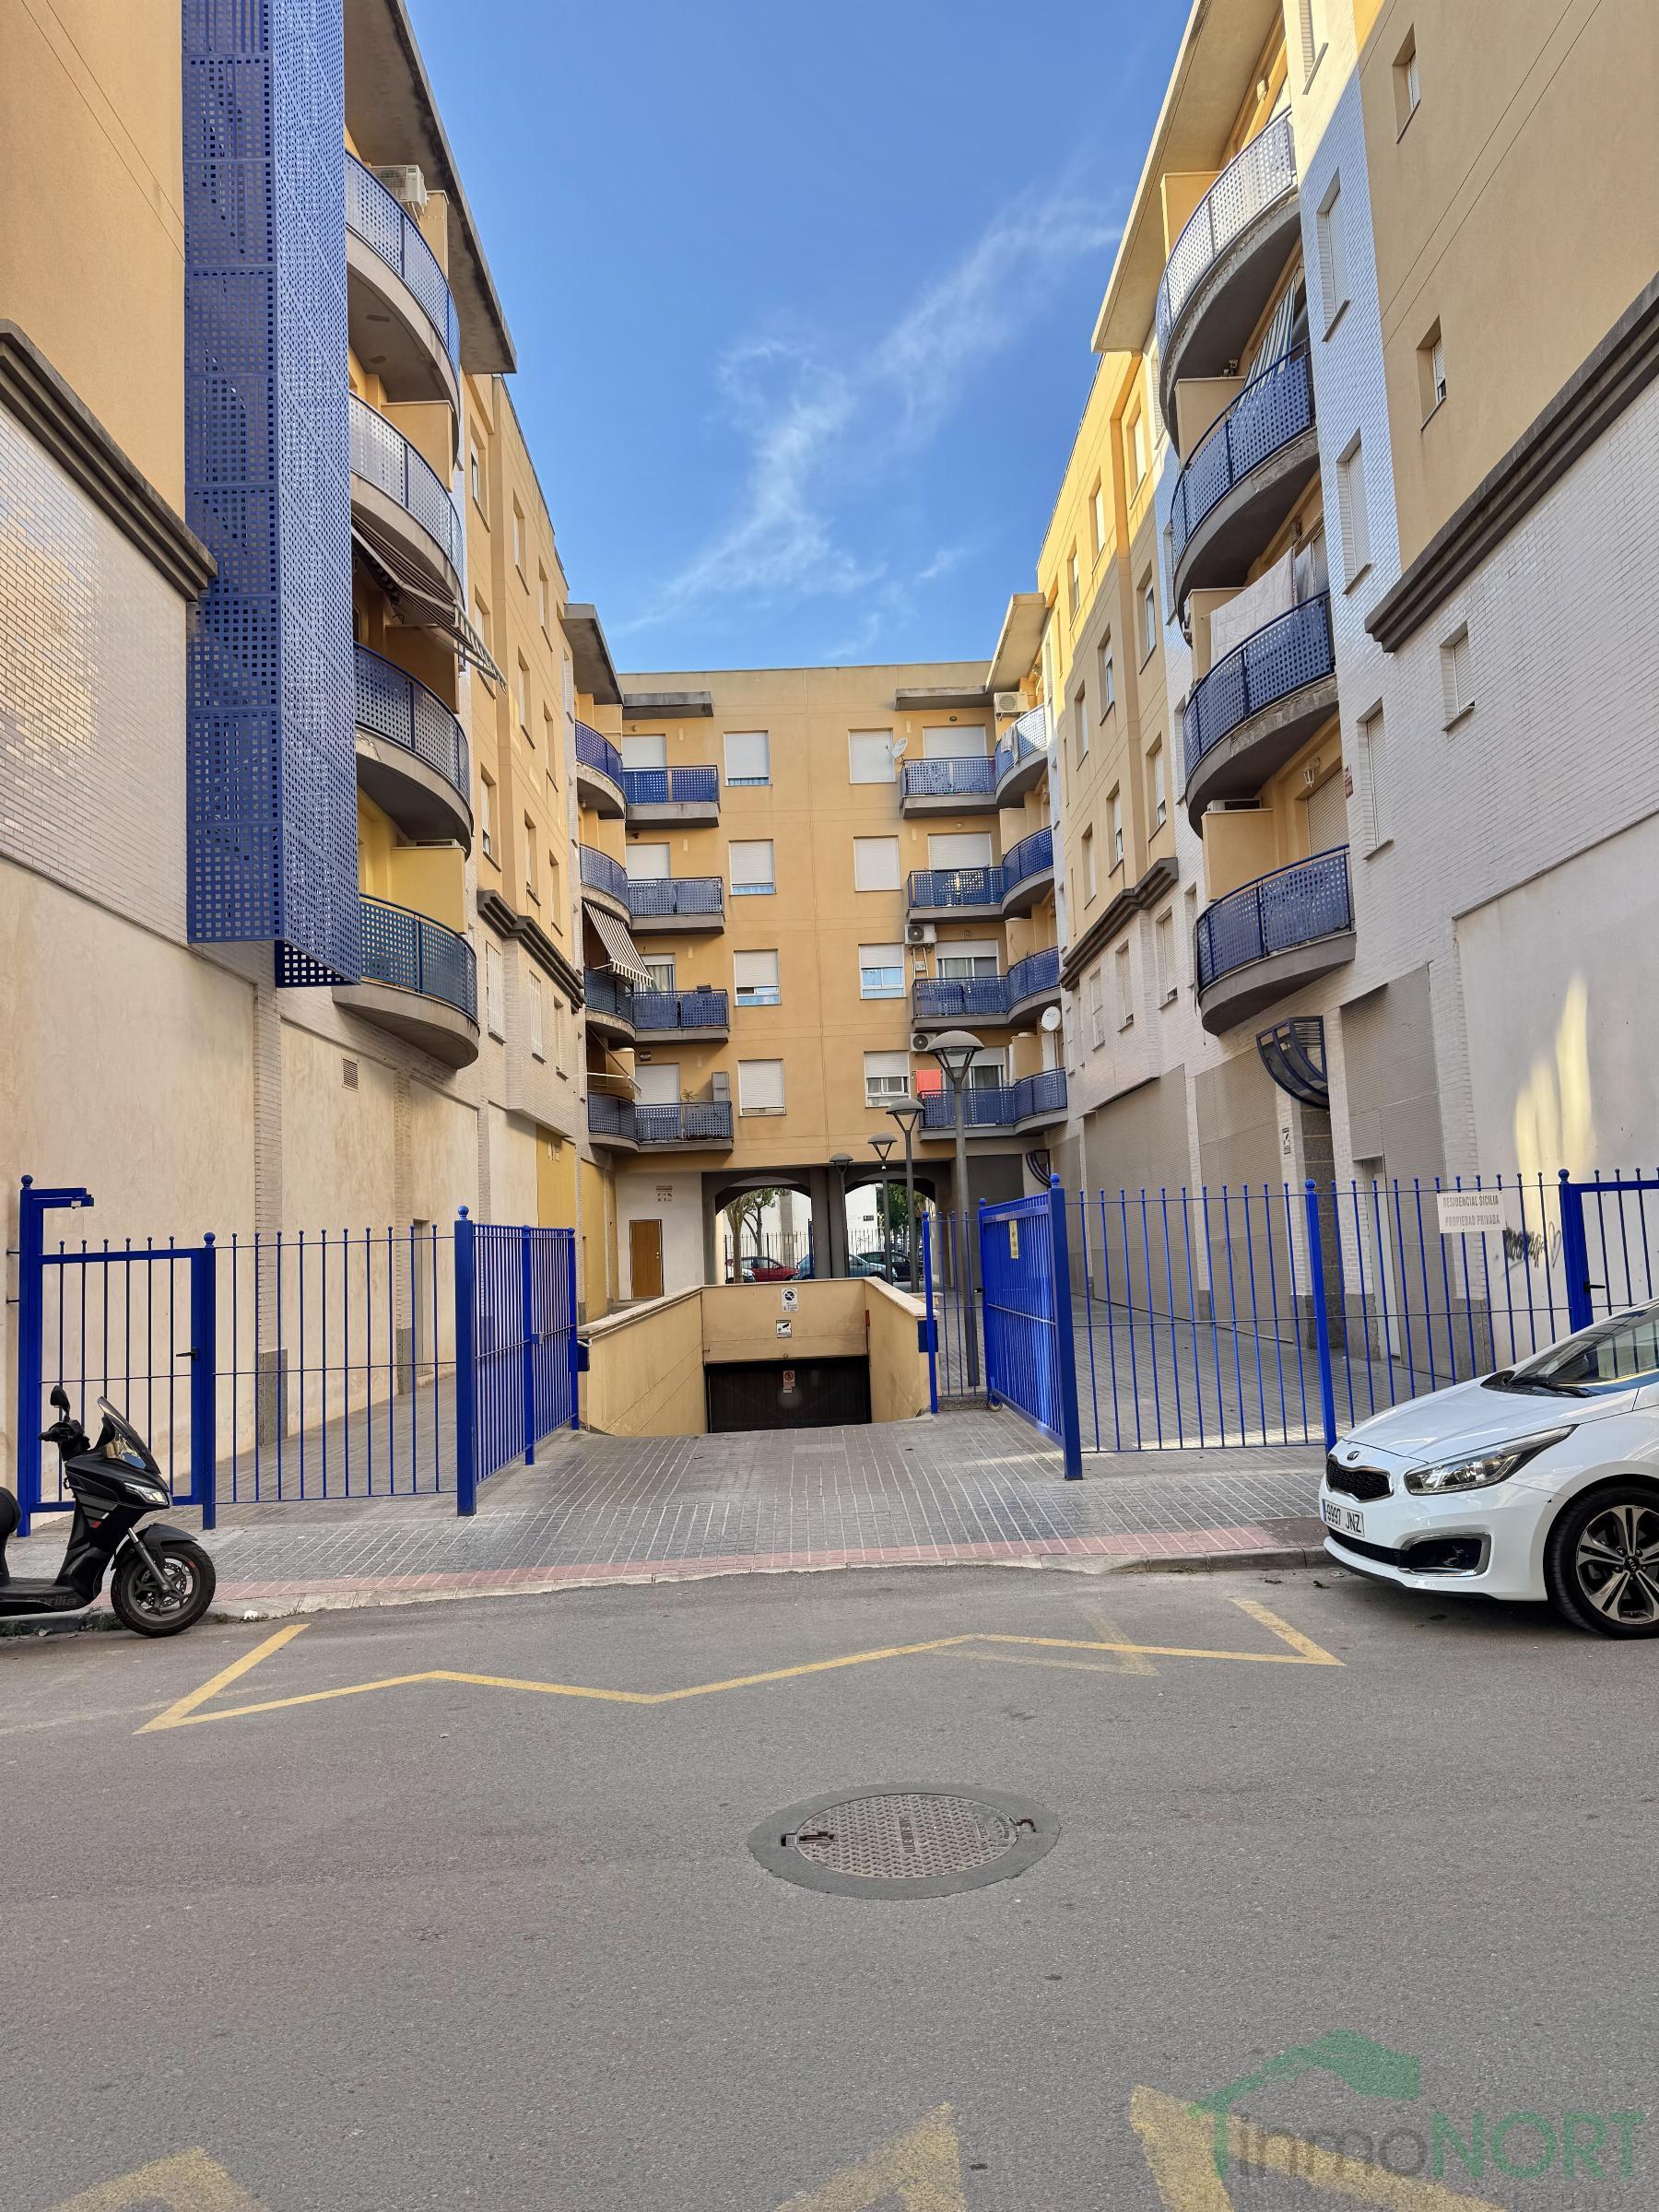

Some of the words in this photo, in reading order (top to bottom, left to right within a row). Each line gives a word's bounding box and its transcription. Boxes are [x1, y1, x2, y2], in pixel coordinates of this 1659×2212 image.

[1442, 1196, 1478, 1208] RESIDENCIAL
[1478, 1194, 1500, 1206] SICILIA
[1445, 1215, 1476, 1227] PROPIEDAD
[1477, 1214, 1500, 1226] PRIVADA
[1346, 1511, 1362, 1533] JNZ
